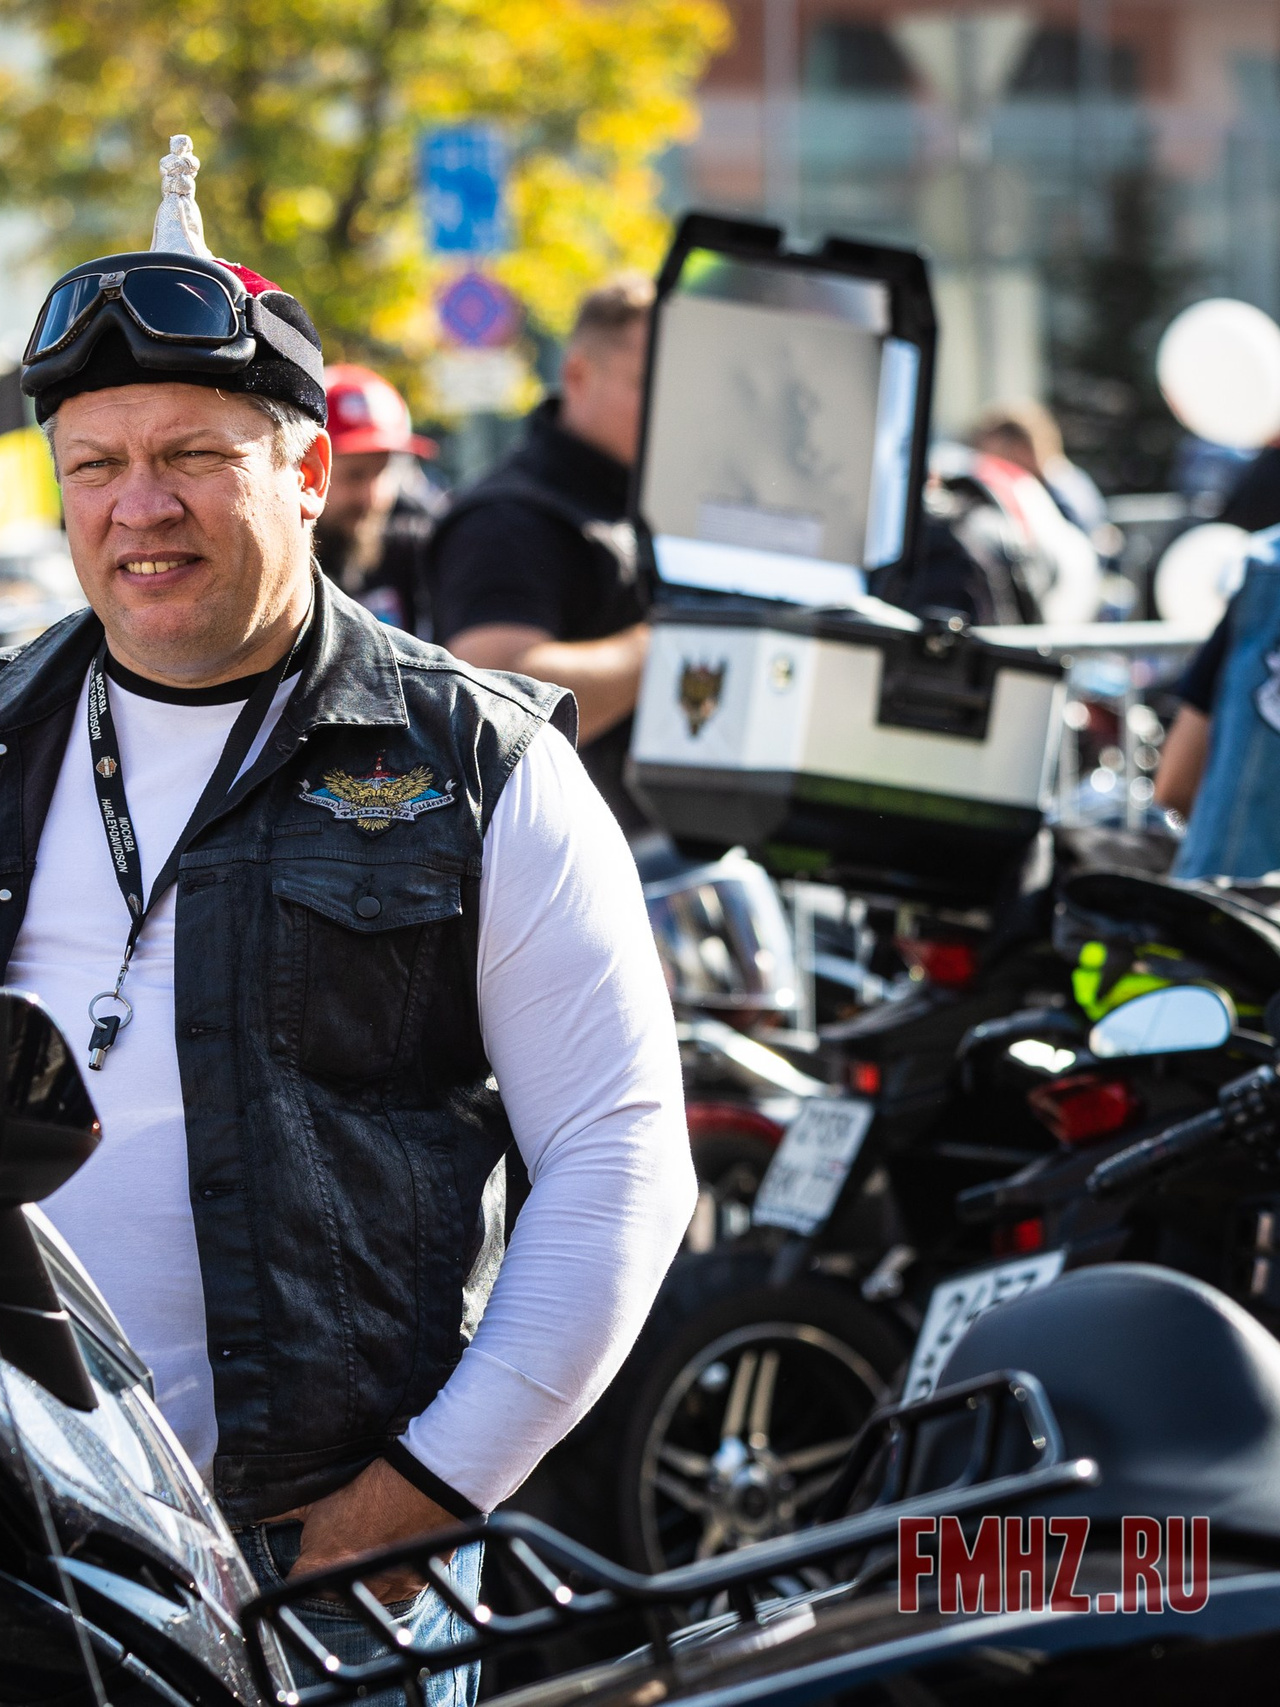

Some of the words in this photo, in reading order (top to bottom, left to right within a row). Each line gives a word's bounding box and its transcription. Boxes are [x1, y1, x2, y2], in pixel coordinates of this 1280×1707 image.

[95, 672, 107, 715] МОСКВА
[101, 798, 128, 873] HARLEY-DAVIDSON
[118, 816, 135, 853] МОСКВА
